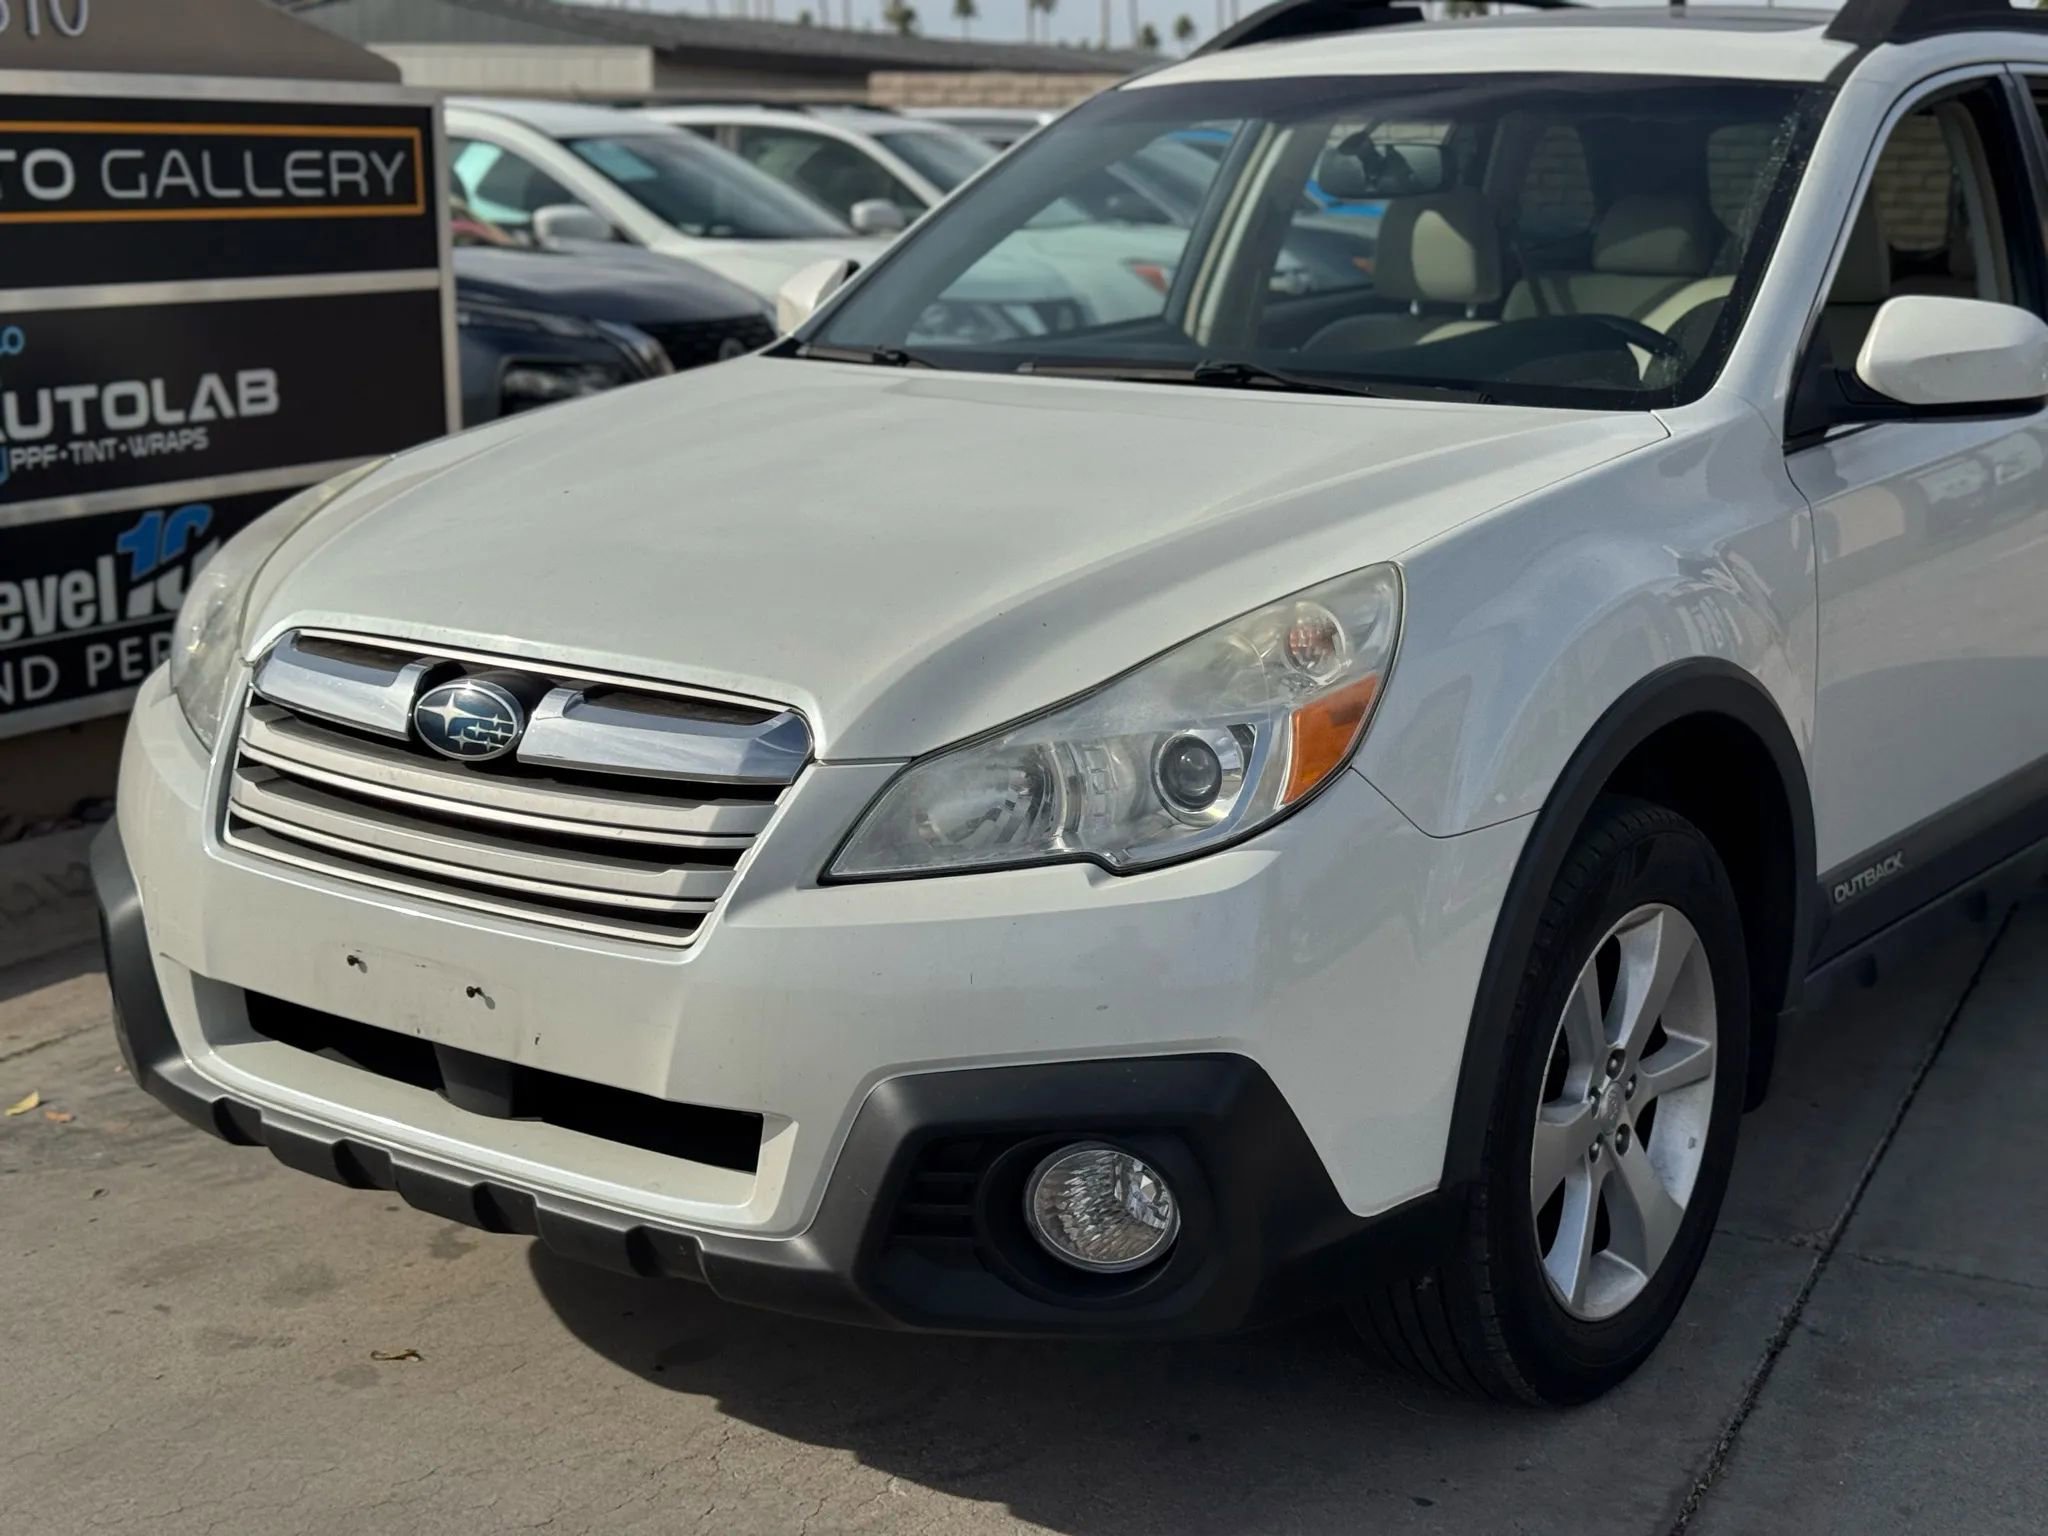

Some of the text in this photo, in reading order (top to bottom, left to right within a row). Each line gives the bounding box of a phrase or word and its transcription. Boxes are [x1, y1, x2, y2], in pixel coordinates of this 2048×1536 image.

[101, 149, 405, 198] GALLERY
[0, 368, 279, 443] UTOLAB
[1834, 851, 1904, 903] OUTBACK
